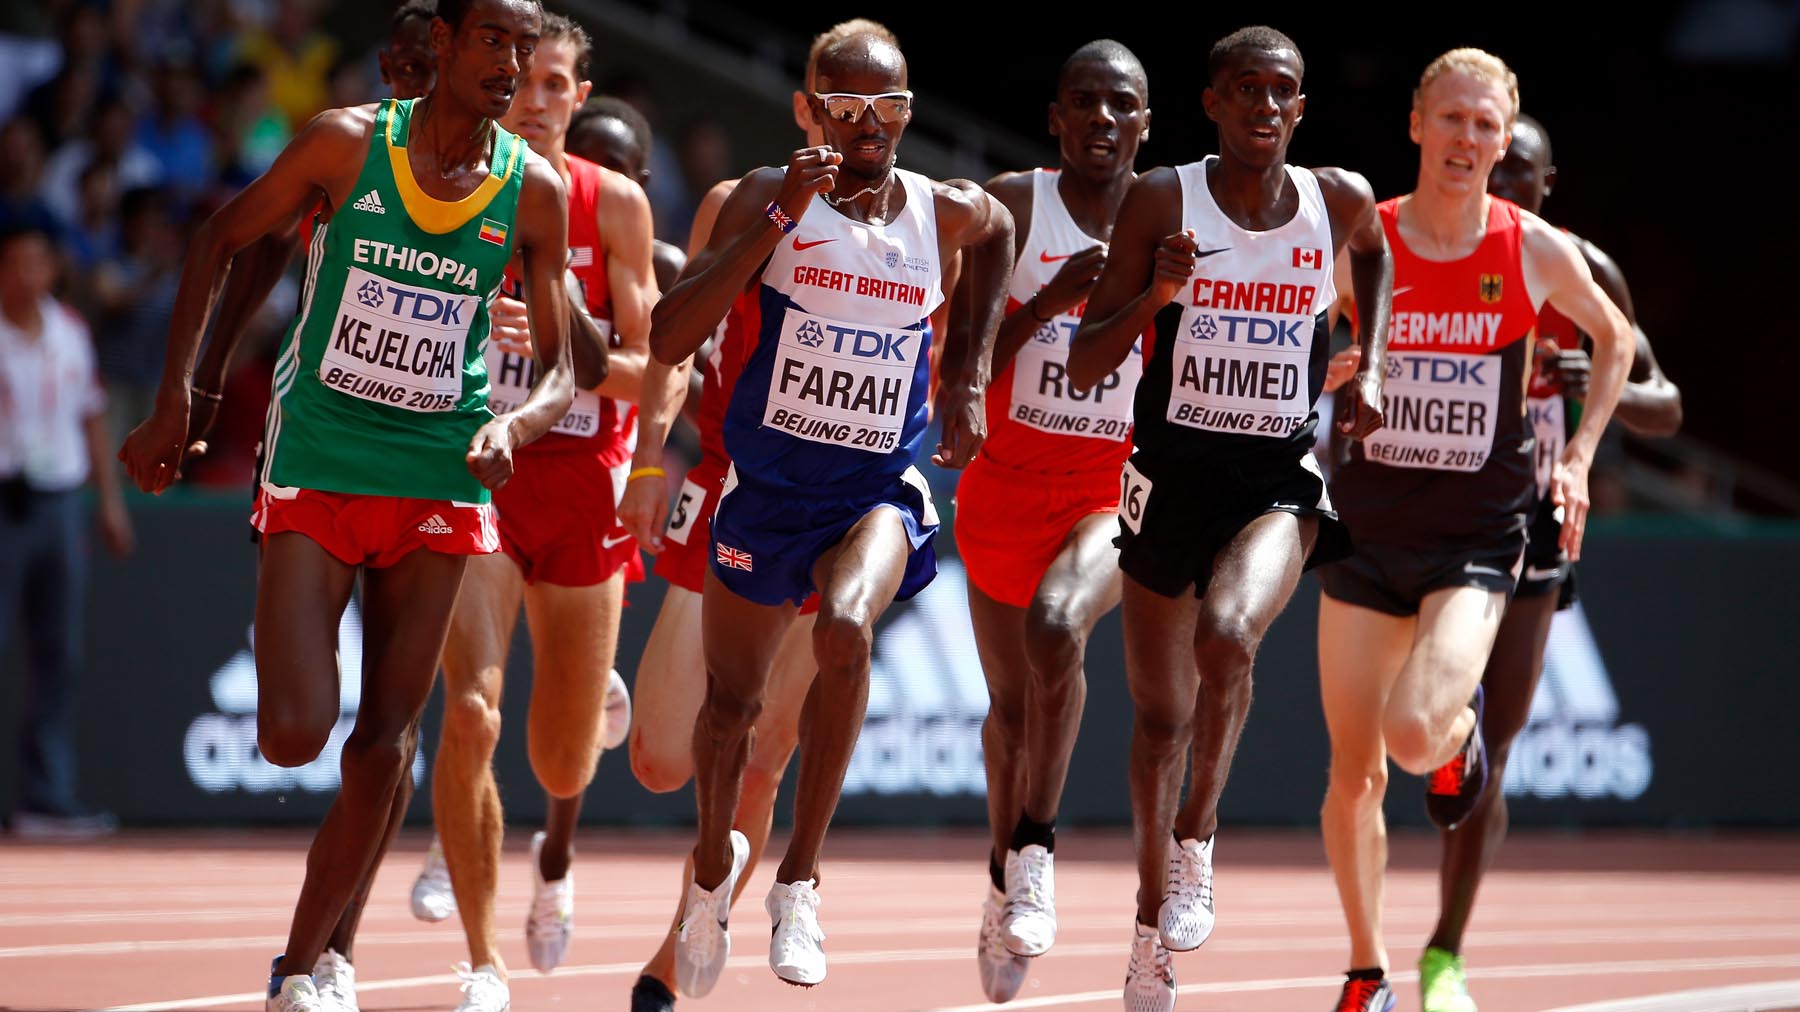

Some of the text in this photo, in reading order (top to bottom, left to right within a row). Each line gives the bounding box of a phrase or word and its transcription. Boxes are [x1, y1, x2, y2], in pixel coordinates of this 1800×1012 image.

[353, 202, 386, 215] adidas
[353, 238, 478, 290] ETHIOPIA
[793, 265, 926, 306] GREAT BRITAIN
[1192, 278, 1316, 315] CANADA
[387, 287, 465, 326] TDK
[334, 314, 456, 379] KEJELCHA
[826, 325, 910, 362] TDK
[1218, 316, 1304, 347] TDK
[325, 367, 455, 411] BEIJING 2015
[779, 357, 902, 417] FARAH
[1179, 355, 1300, 401] AHMED
[1402, 356, 1487, 386] TDK
[556, 412, 593, 432] 015
[770, 408, 896, 450] BEIJING 2015
[1015, 404, 1091, 432] BEIJING
[1175, 403, 1303, 434] BEIJING 2015
[1371, 443, 1485, 468] BEIJING 2015
[670, 493, 693, 530] 5
[1122, 471, 1144, 522] 16
[418, 525, 453, 535] adidas
